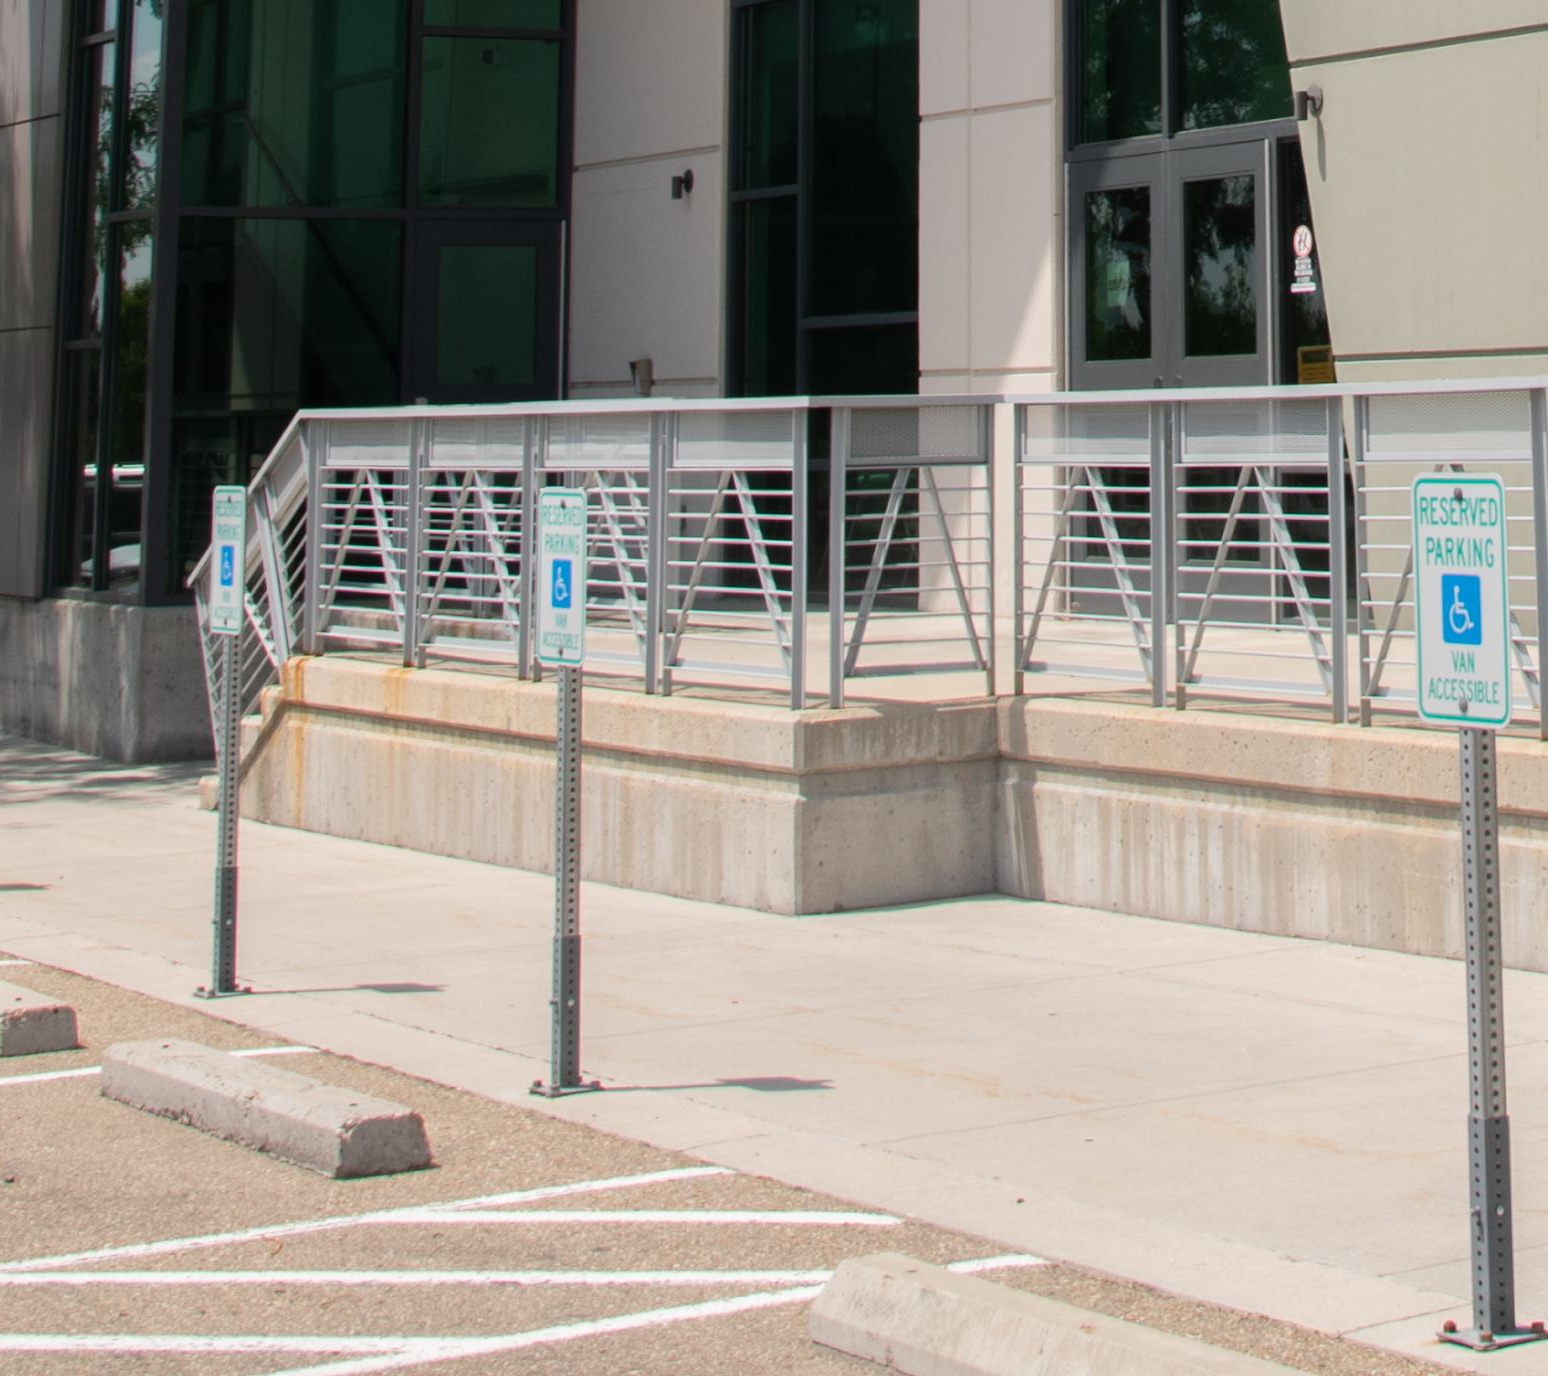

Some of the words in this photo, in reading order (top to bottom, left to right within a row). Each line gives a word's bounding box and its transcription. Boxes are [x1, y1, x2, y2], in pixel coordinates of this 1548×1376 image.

[542, 504, 583, 527] RESERVED
[1419, 496, 1499, 527] RESERVED
[544, 533, 580, 556] PARKING
[1425, 536, 1495, 569] PARKING
[555, 613, 568, 629] VAN
[542, 632, 579, 650] ACCESSIBLE
[1451, 650, 1476, 675] VAN
[1428, 677, 1500, 705] ACCESSIBLE
